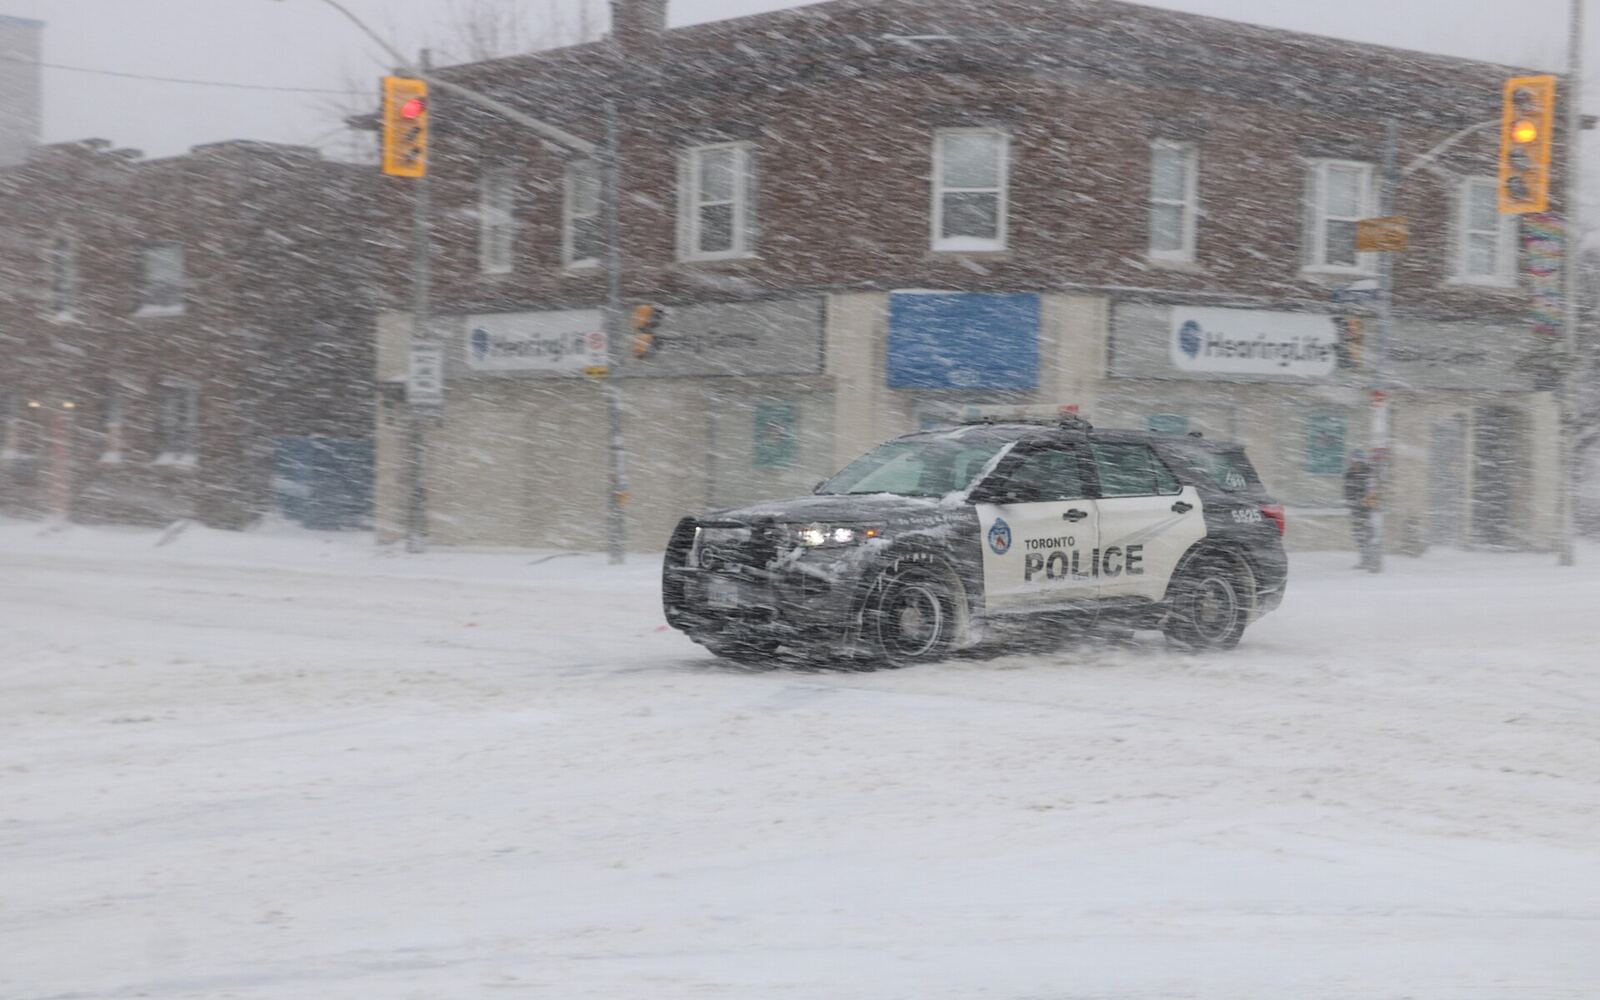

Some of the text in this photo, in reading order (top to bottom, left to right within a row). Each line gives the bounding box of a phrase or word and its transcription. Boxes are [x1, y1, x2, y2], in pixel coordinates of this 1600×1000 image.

[1204, 332, 1330, 367] HearingLife
[1024, 536, 1076, 550] TORONTO
[1024, 544, 1144, 582] POLICE
